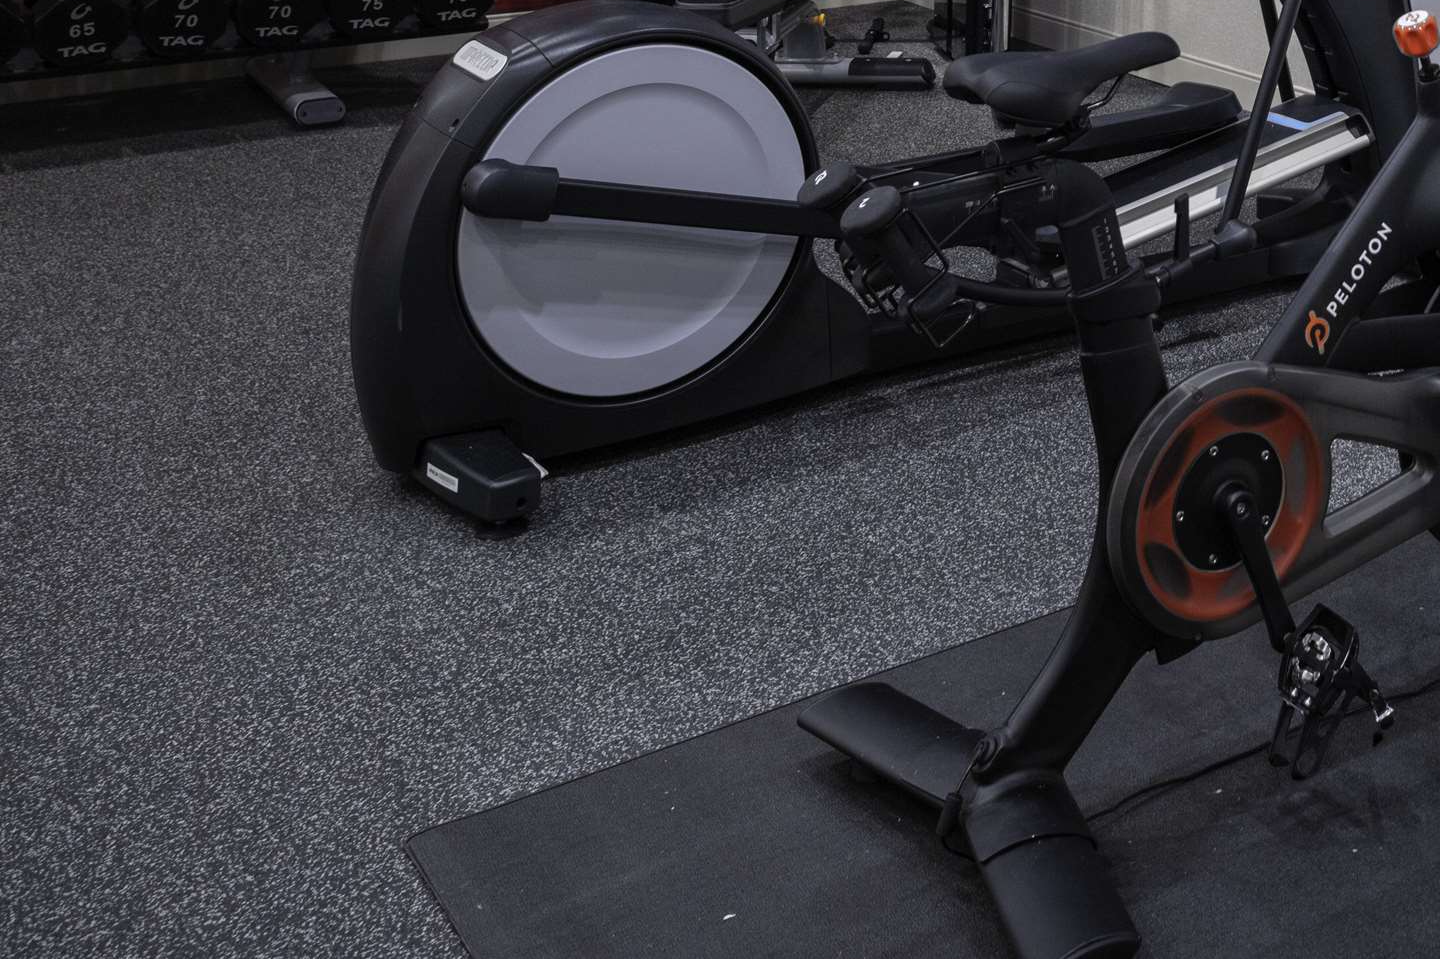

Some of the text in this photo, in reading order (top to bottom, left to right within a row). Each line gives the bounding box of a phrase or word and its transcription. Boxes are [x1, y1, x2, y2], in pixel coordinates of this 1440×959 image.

[268, 5, 292, 20] 70
[436, 7, 477, 22] TAG
[174, 14, 199, 28] 70
[348, 16, 390, 29] TAG
[69, 21, 96, 39] 65
[255, 25, 299, 38] TAG
[159, 34, 204, 47] TAG
[57, 42, 107, 58] TAG
[1326, 222, 1393, 317] PELOTON
